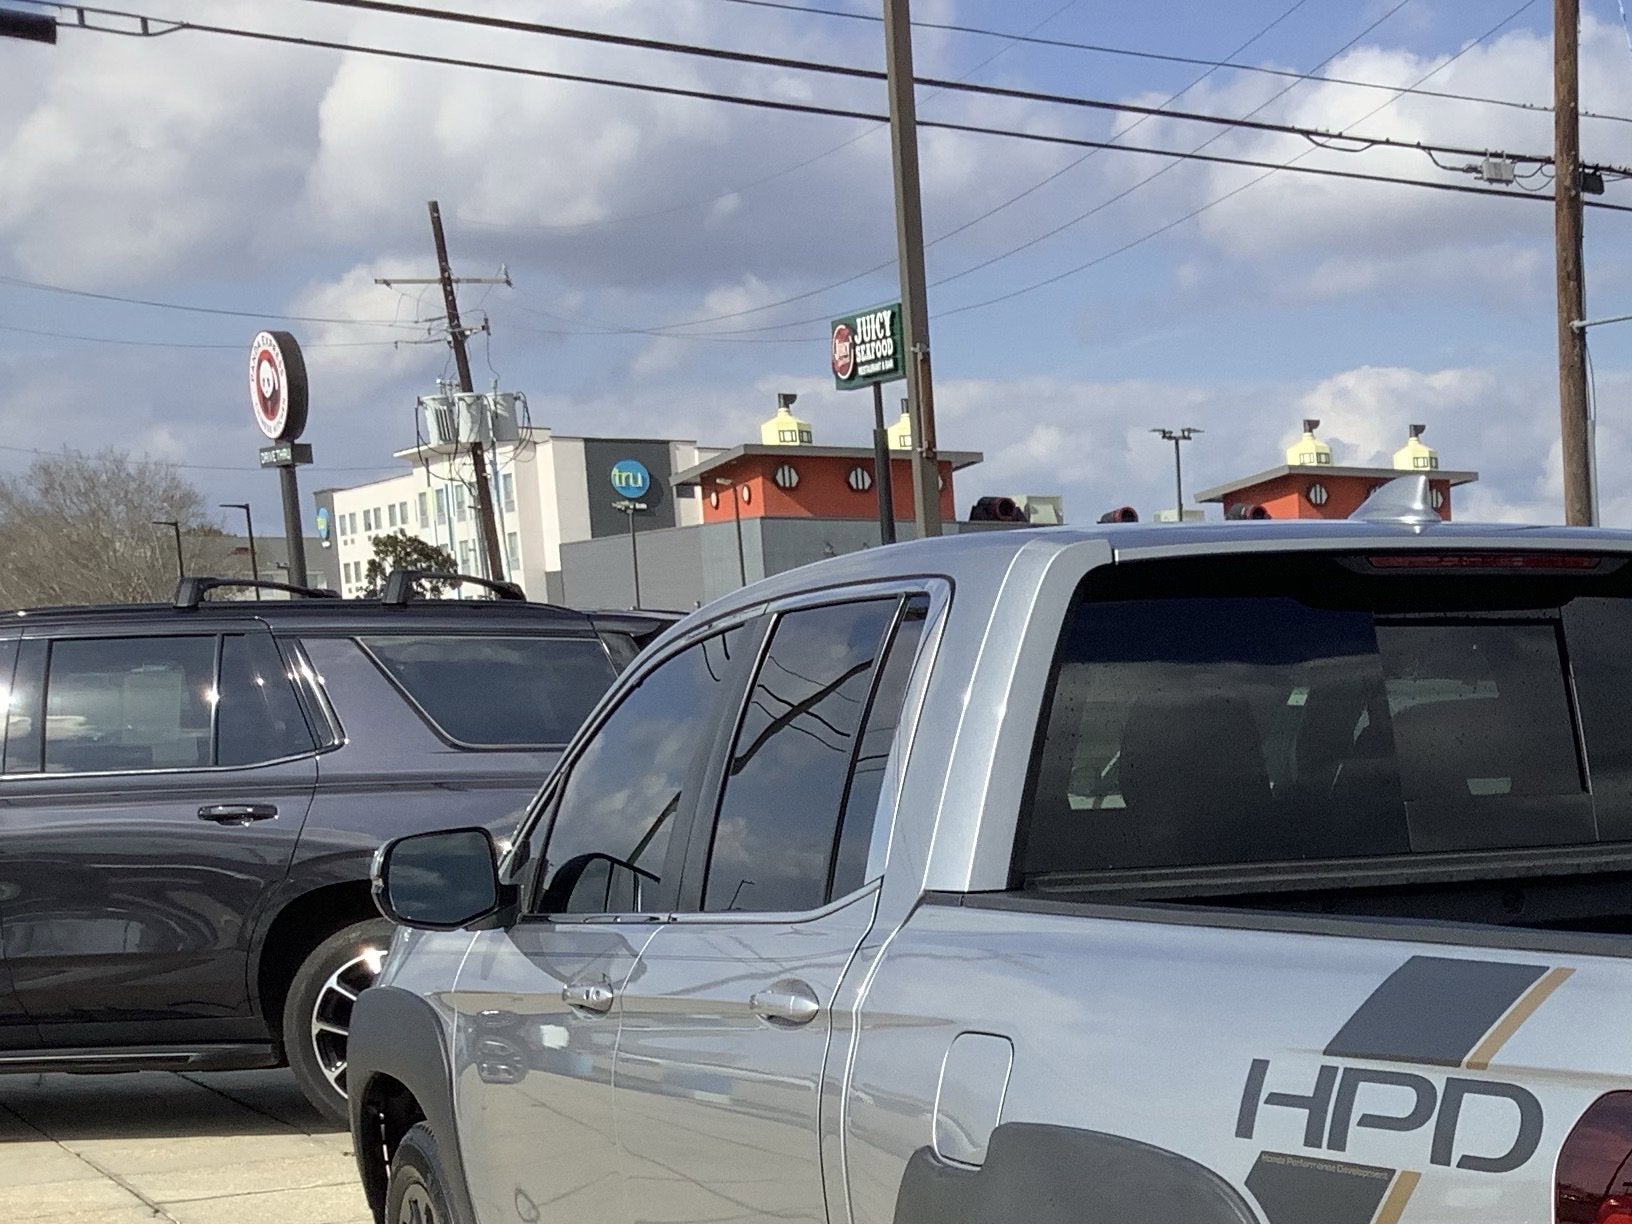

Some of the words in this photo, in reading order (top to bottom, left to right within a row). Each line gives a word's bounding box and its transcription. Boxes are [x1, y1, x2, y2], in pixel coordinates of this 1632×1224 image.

[854, 310, 892, 345] JUICY
[855, 338, 894, 362] SEAFOOD
[612, 467, 643, 487] tru
[1235, 1058, 1544, 1173] HPD
